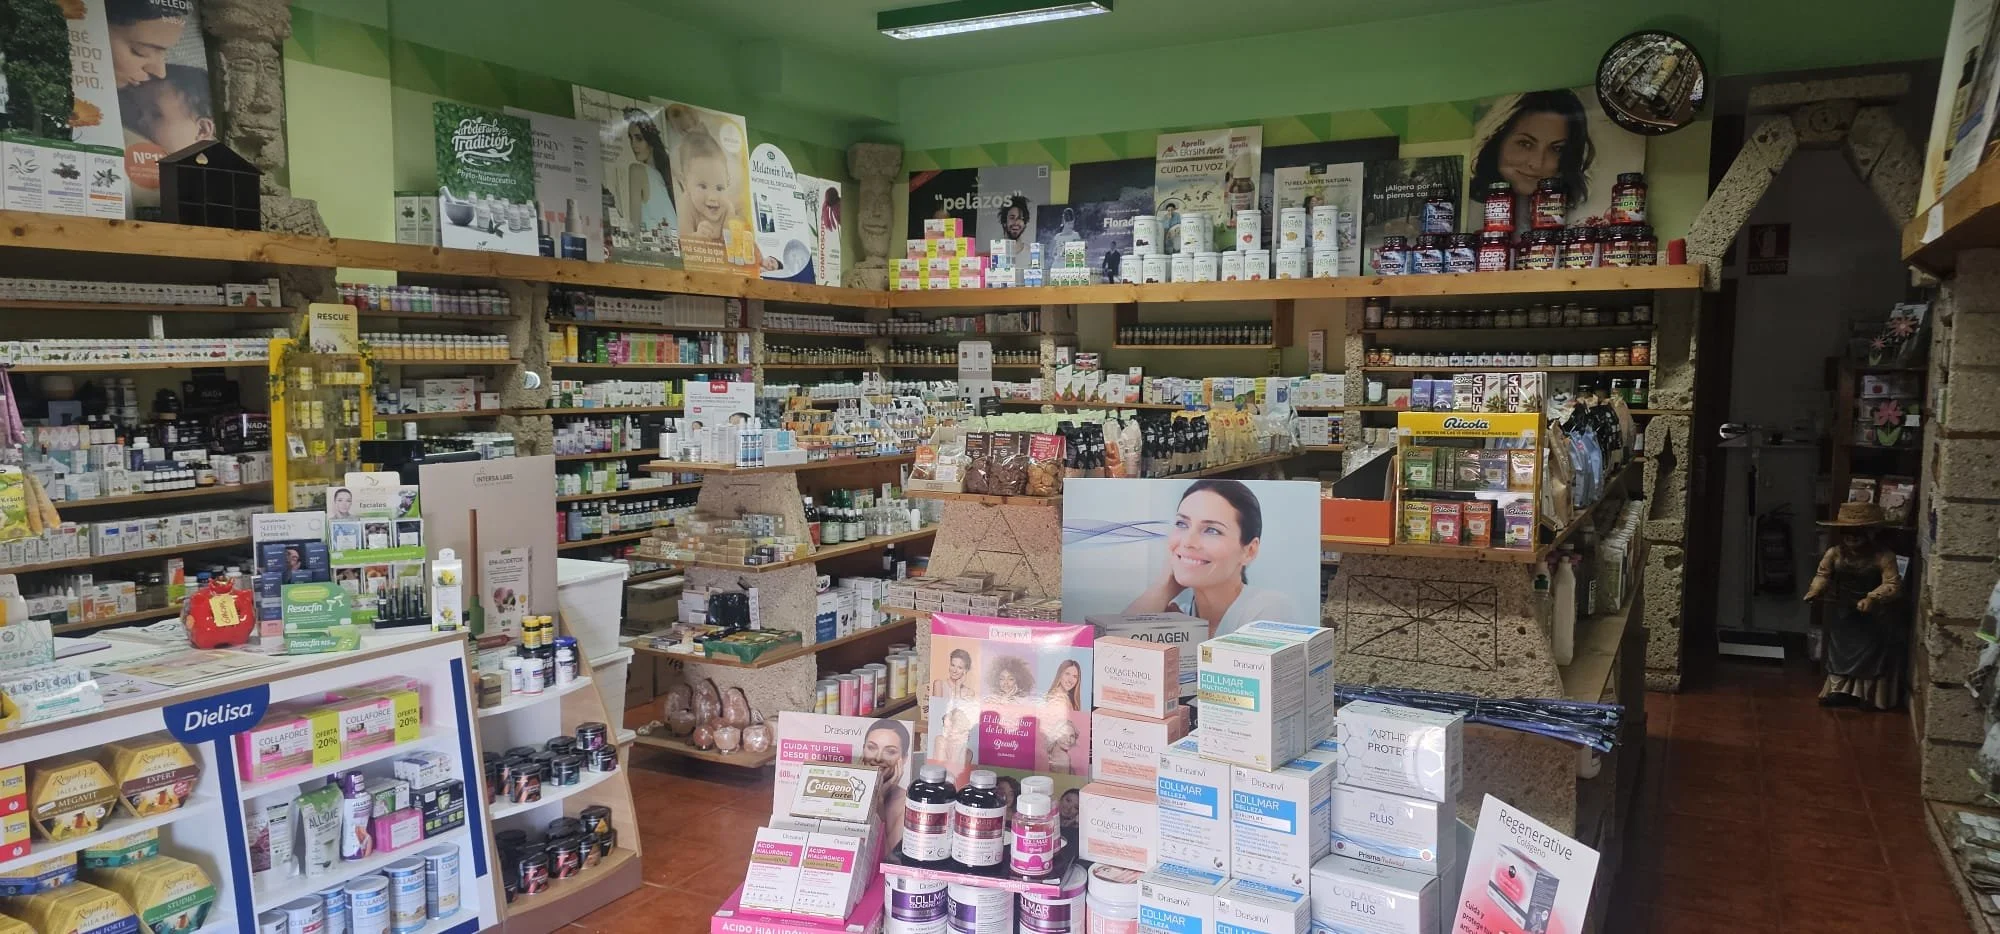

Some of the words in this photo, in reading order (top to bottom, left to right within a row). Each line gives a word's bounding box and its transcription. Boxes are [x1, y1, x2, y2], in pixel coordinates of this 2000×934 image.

[70, 30, 89, 44] BÉ
[452, 133, 509, 151] Tradición
[1180, 148, 1205, 157] ERYSIM
[1160, 164, 1188, 175] CUIDA
[1191, 164, 1203, 172] TU
[1204, 162, 1224, 172] VOZ
[1386, 192, 1414, 200] piernas
[1104, 216, 1134, 228] Florad
[317, 312, 350, 321] RESCUE
[1443, 417, 1490, 430] Ricola
[1104, 665, 1152, 681] COLAGENPOL
[1233, 659, 1265, 672] Drasanvi
[1201, 673, 1244, 688] COLLMAR
[184, 703, 252, 732] Dielisa
[346, 708, 392, 725] COLLAFORCE
[397, 708, 418, 718] OFERTA
[398, 716, 419, 729] -20%
[258, 727, 309, 746] COLLAFORCE
[315, 727, 338, 739] OFERTA
[824, 724, 862, 737] Drasanvi
[1370, 727, 1410, 744] ARTHR
[315, 736, 338, 750] -20%
[783, 742, 809, 751] CUIDA
[810, 743, 821, 752] TU
[823, 745, 841, 754] PIEL
[1104, 738, 1155, 754] COLAGENPOL
[783, 750, 810, 760] DESDE
[811, 753, 845, 763] DENTRO
[1367, 742, 1416, 761] PROTECT
[146, 771, 176, 784] EXPERT
[1175, 764, 1207, 777] Drasanvi
[806, 778, 852, 795] Colágeno
[1159, 780, 1202, 797] COLLMAR
[1251, 776, 1285, 791] Drasanvi
[58, 791, 97, 808] MEGAVIT
[830, 791, 853, 800] forte
[1159, 789, 1187, 800] BELLEZA
[1234, 793, 1279, 811] COLLMAR
[1234, 803, 1263, 814] BELLEZA
[1090, 817, 1143, 835] COLAGENPOL
[1369, 811, 1395, 826] PLUS
[1499, 809, 1573, 861] Regenerative
[1516, 835, 1547, 859] Colágeno
[909, 891, 946, 905] COLLMA
[1020, 896, 1049, 914] LLMAR
[1158, 892, 1190, 907] Drasanvi
[1350, 900, 1377, 915] PLUS
[1465, 900, 1480, 916] Cuida
[1141, 907, 1186, 926] COLLMAR
[1141, 917, 1170, 930] BELLEZA
[1235, 908, 1269, 924] Drasanvi
[1462, 912, 1484, 930] protege
[103, 920, 126, 932] FORTE
[722, 921, 753, 933] ÁCIDO
